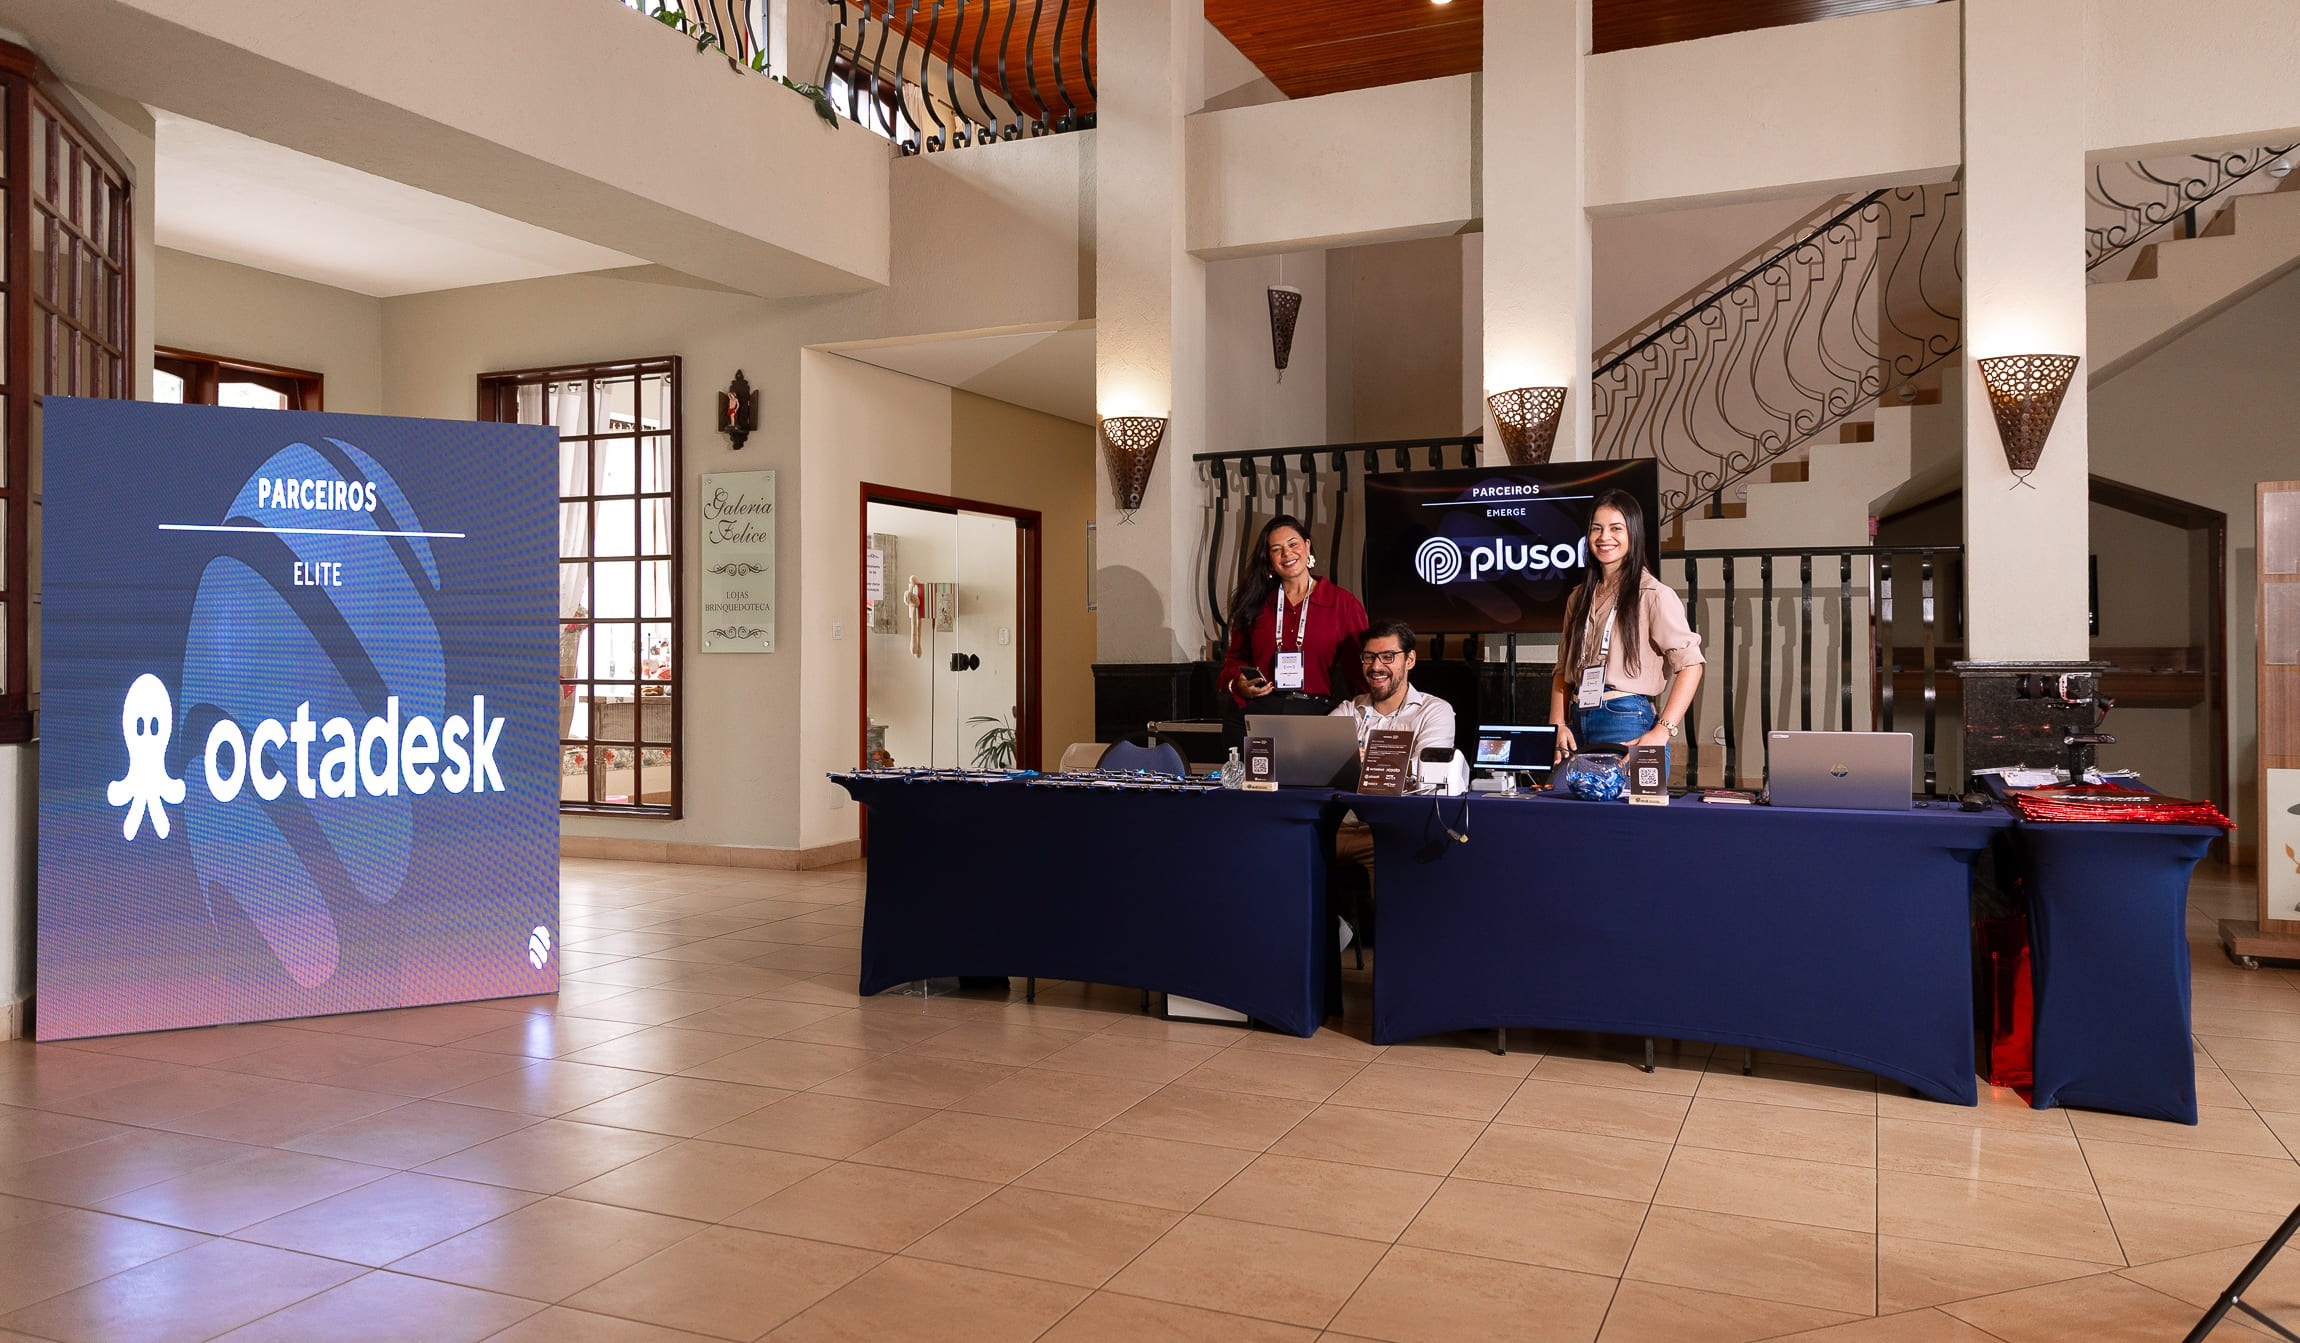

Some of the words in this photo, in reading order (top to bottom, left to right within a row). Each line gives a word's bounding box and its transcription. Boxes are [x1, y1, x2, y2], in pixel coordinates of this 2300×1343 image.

[257, 477, 377, 512] PARCEIROS
[703, 487, 772, 520] Galeria
[1472, 484, 1540, 498] PARCEIROS
[1486, 507, 1527, 517] EMERGE
[709, 519, 767, 545] Felice
[1470, 536, 1586, 580] plusof
[293, 561, 343, 587] ELITE
[705, 603, 770, 613] BRINQUEDOTECA
[726, 591, 749, 601] LOJAS
[203, 694, 506, 803] octadesk
